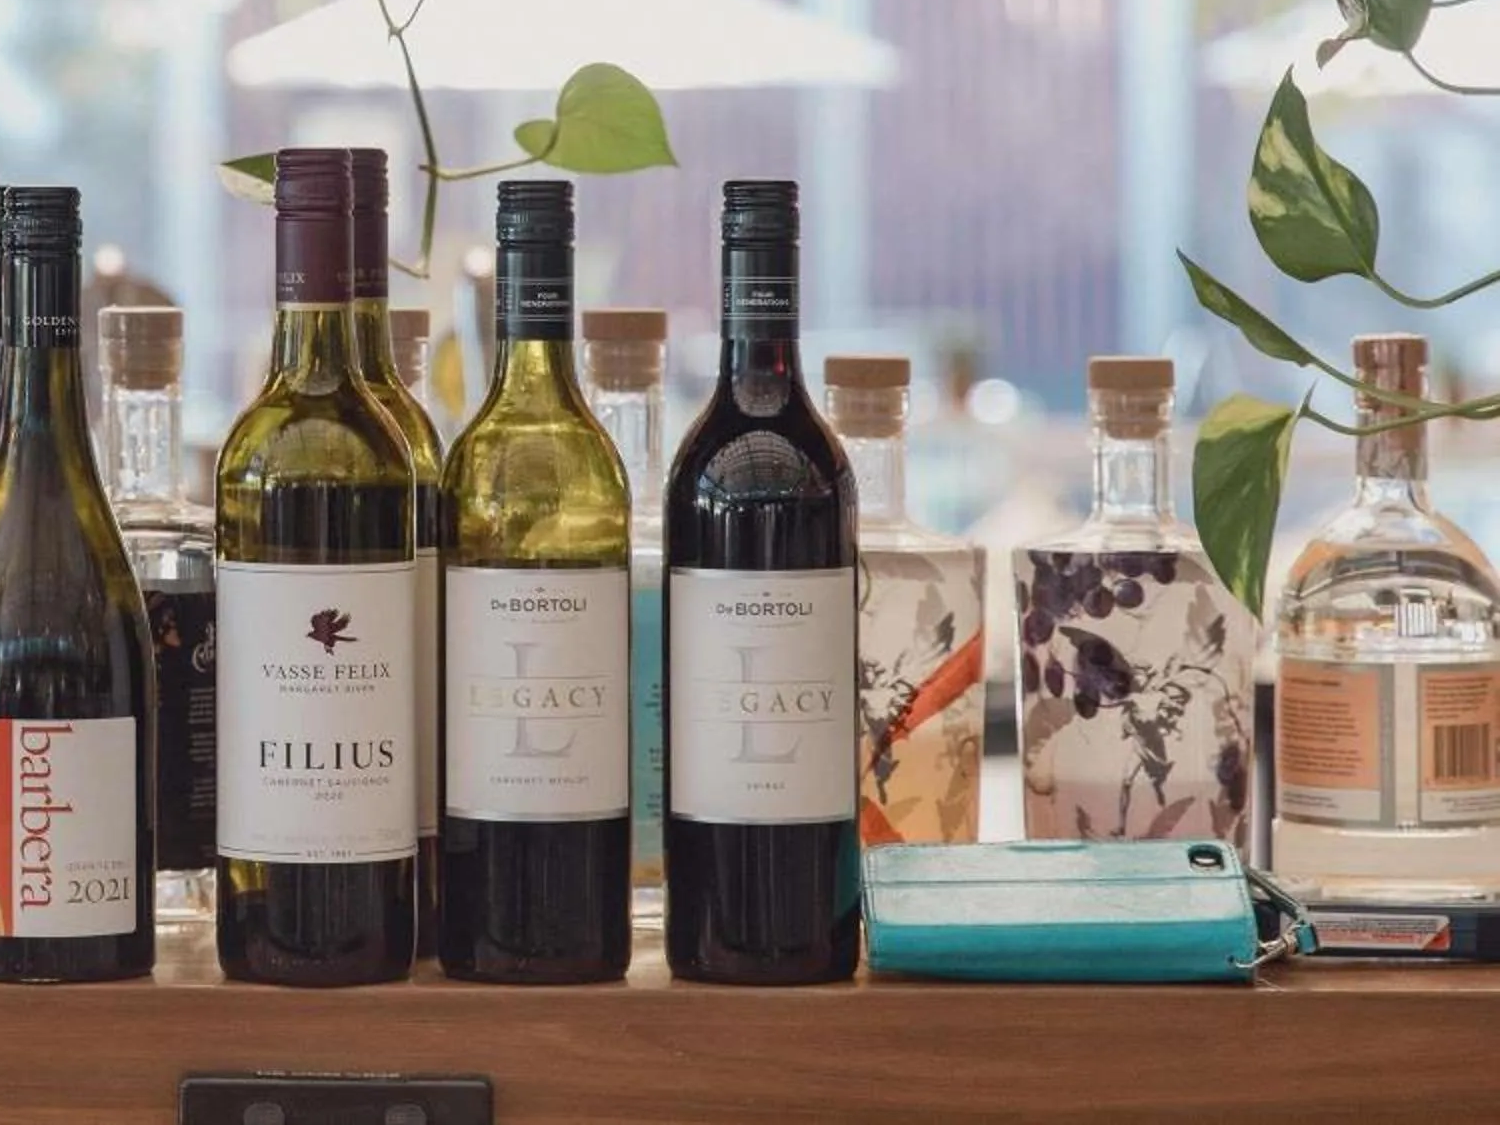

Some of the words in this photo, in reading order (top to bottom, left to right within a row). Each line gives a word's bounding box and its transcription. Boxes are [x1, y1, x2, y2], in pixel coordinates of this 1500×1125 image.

[261, 663, 326, 680] VASSE
[334, 661, 391, 680] FELIX
[259, 738, 394, 770] FILIUS
[19, 722, 74, 912] barbera
[66, 876, 130, 904] 2021
